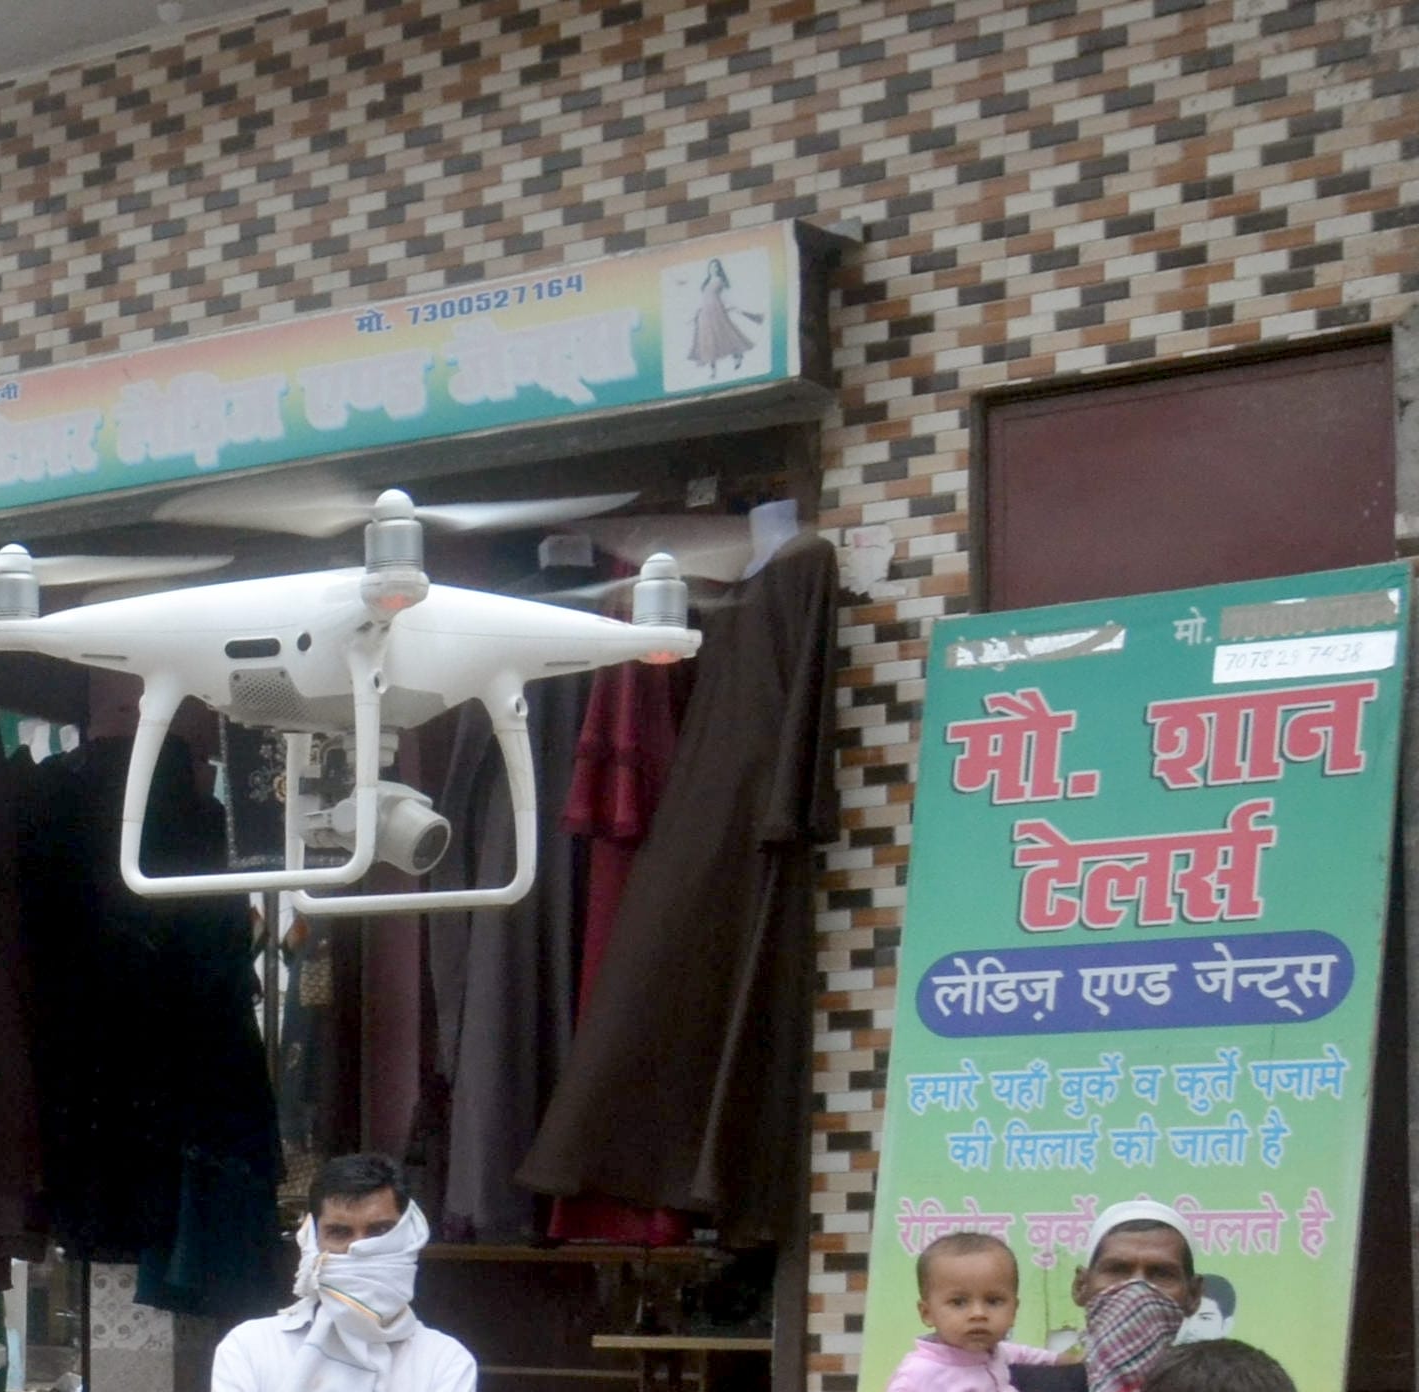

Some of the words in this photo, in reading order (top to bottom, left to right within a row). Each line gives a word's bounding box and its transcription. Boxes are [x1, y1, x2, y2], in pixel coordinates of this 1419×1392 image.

[406, 272, 585, 326] 7300527164
[946, 688, 1100, 804] मौ.
[1147, 680, 1379, 789] शान
[1011, 800, 1277, 931] टेलर्स
[932, 957, 1063, 1020] लेडिज़
[1078, 963, 1177, 1015] एण्ड
[908, 1059, 982, 1113] हमारे
[991, 1061, 1050, 1111] यहाँ
[1059, 1053, 1123, 1117] बुर्के
[1130, 1066, 1164, 1103] व
[1173, 1047, 1241, 1113] कुर्ते
[1250, 1045, 1349, 1099] पजामे
[948, 1118, 995, 1169] की
[1003, 1114, 1101, 1172] सिलाई
[1110, 1113, 1161, 1168] की
[1168, 1110, 1251, 1166] जाती
[1259, 1107, 1290, 1168] है
[1297, 1188, 1334, 1255] है
